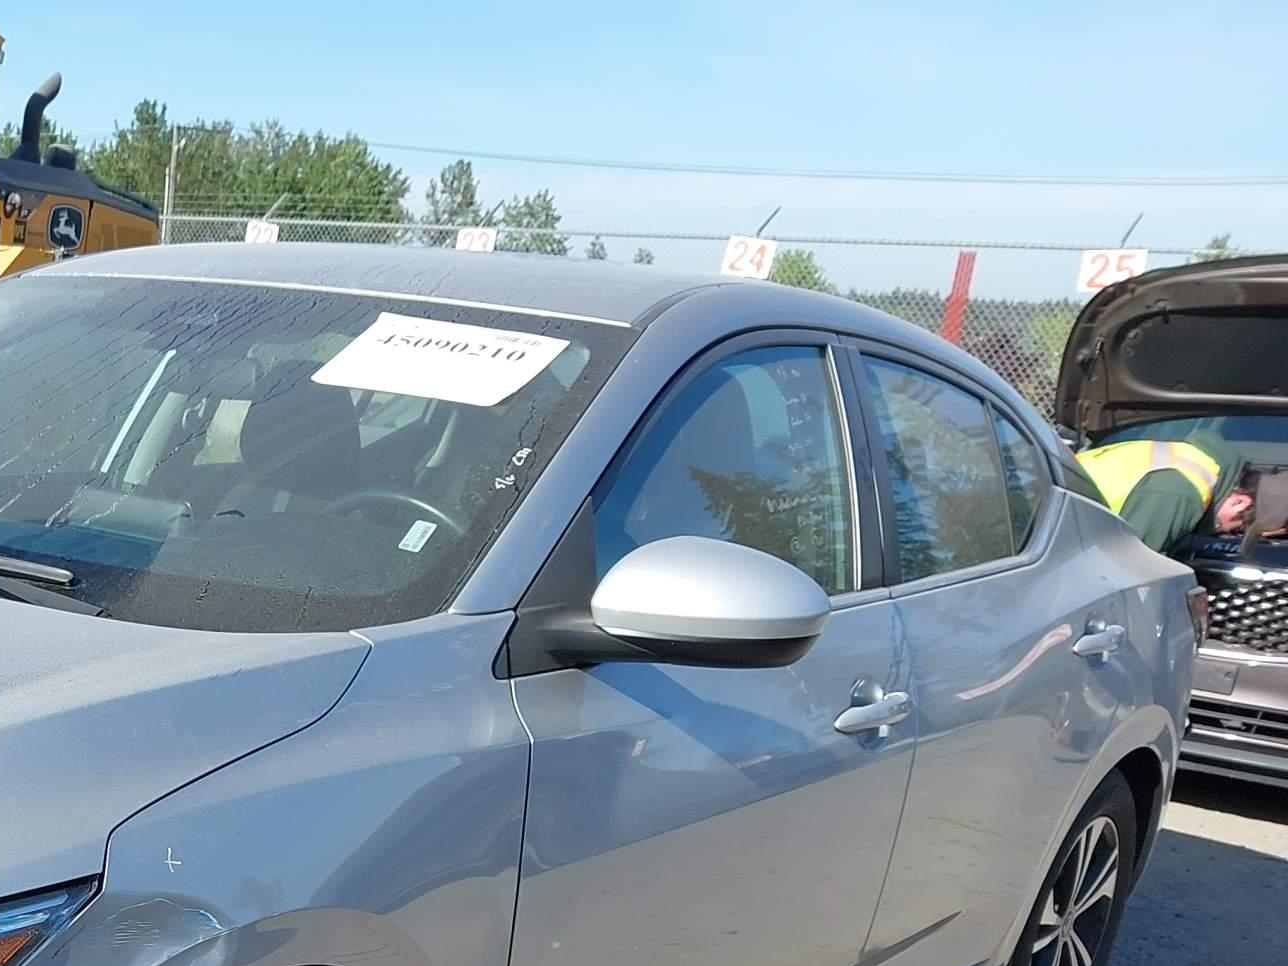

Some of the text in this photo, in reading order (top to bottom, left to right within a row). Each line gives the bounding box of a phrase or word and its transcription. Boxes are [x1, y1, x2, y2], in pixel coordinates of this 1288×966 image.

[729, 241, 766, 272] 24
[1087, 254, 1136, 287] 25
[377, 334, 526, 362] 45090210
